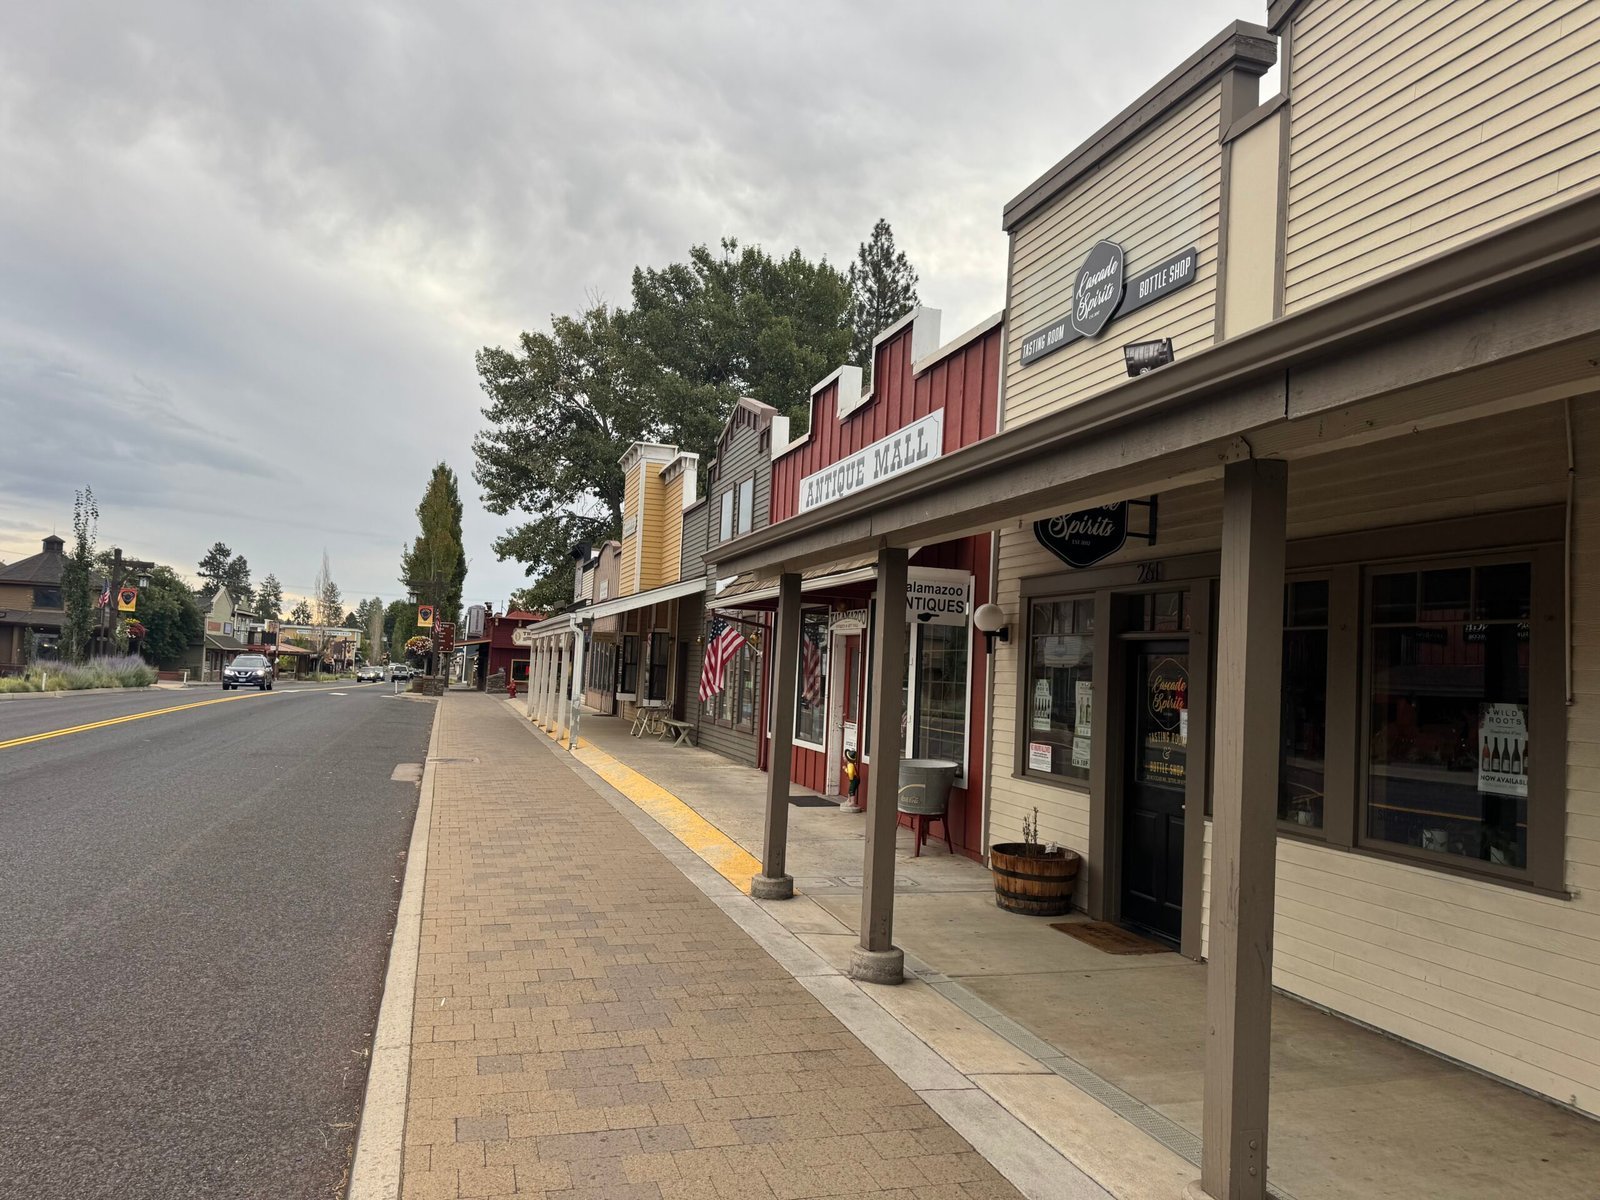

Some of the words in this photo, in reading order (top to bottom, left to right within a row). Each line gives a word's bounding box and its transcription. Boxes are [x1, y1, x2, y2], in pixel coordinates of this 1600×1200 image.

[1075, 254, 1119, 300] Cascade
[1138, 269, 1168, 299] BOTTLE
[1168, 256, 1192, 283] SHOP
[1076, 282, 1115, 322] Spirits
[1022, 336, 1046, 360] TASTING
[1046, 324, 1065, 346] ROOM
[805, 456, 865, 508] ANTIQUE
[873, 427, 929, 479] MALL
[1048, 512, 1116, 541] Spirits
[1136, 561, 1159, 584] 261
[906, 581, 963, 596] alamazoo
[906, 596, 965, 614] NTIQUES
[1152, 675, 1187, 694] Cascade
[1152, 692, 1185, 713] Spirits
[1488, 716, 1522, 726] ROOTS
[1148, 731, 1170, 744] TASTING
[1162, 746, 1171, 760] &
[1149, 760, 1169, 774] BOTTLE
[1481, 774, 1496, 782] NOW
[1496, 776, 1527, 786] AVAILABL
